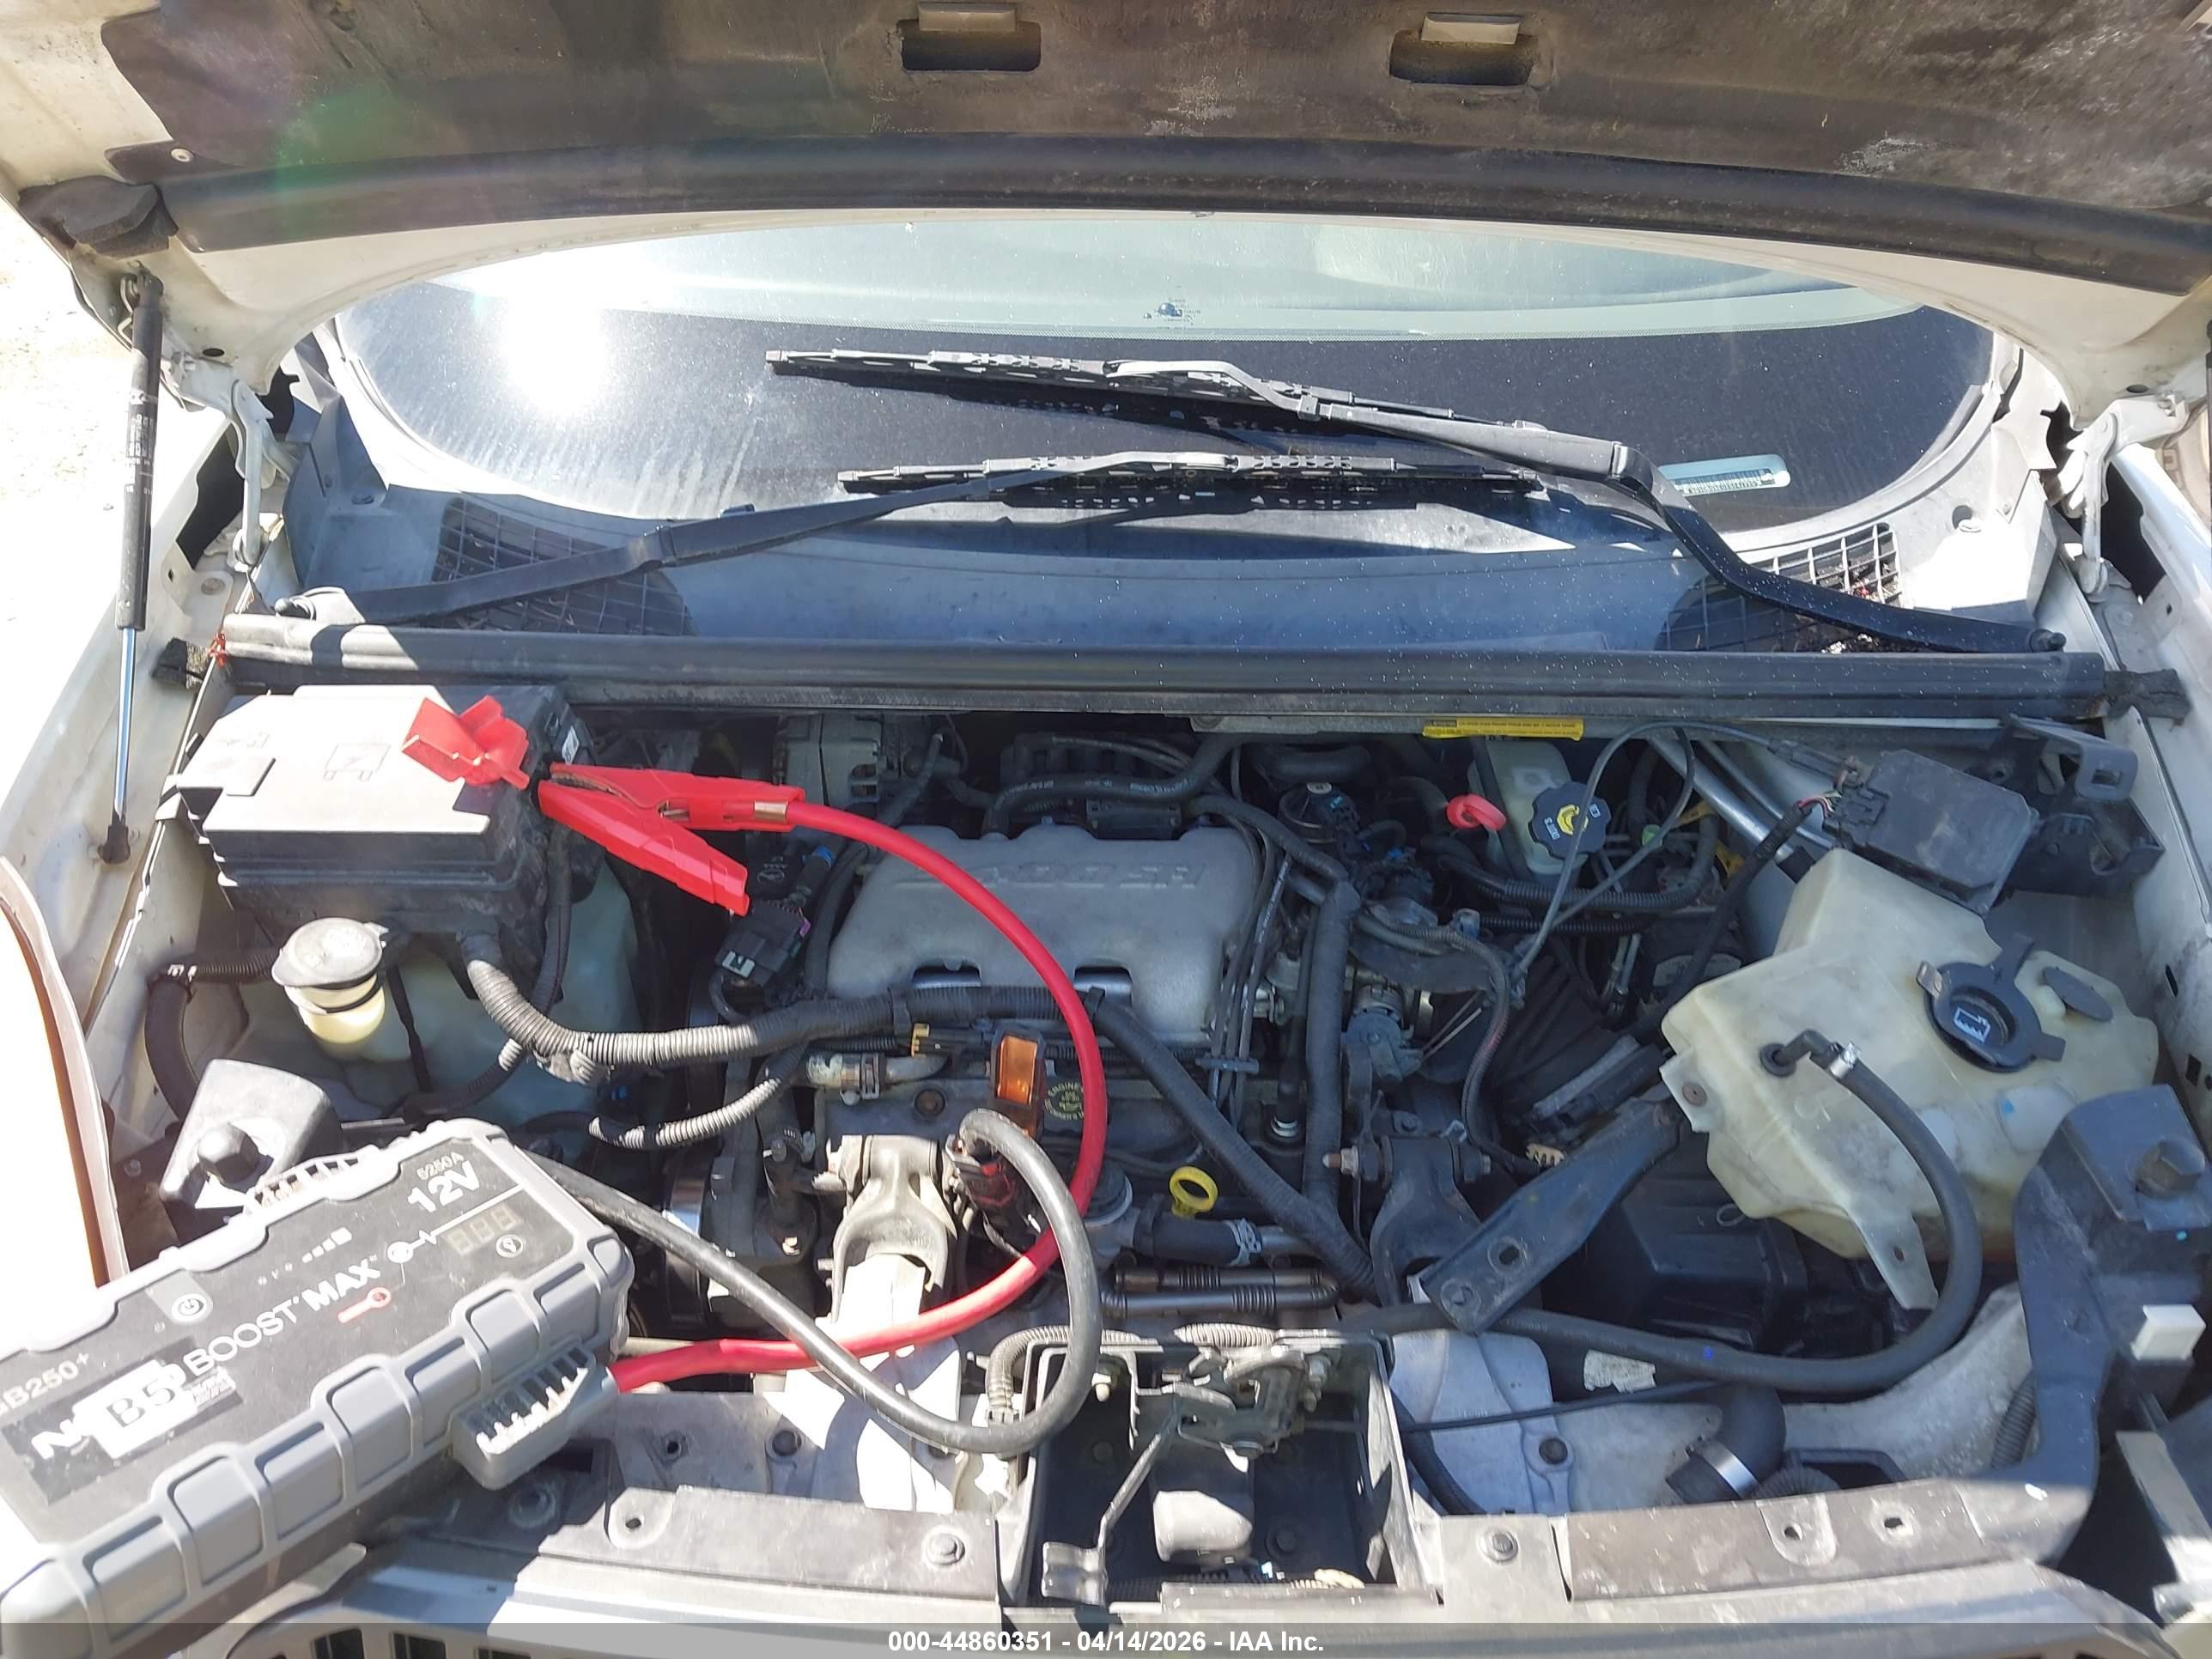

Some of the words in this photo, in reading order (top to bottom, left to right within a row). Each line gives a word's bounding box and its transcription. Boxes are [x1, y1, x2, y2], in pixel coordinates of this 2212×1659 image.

[407, 1160, 481, 1212] 12V
[183, 1299, 297, 1376] BOOST
[105, 1377, 176, 1428] B5
